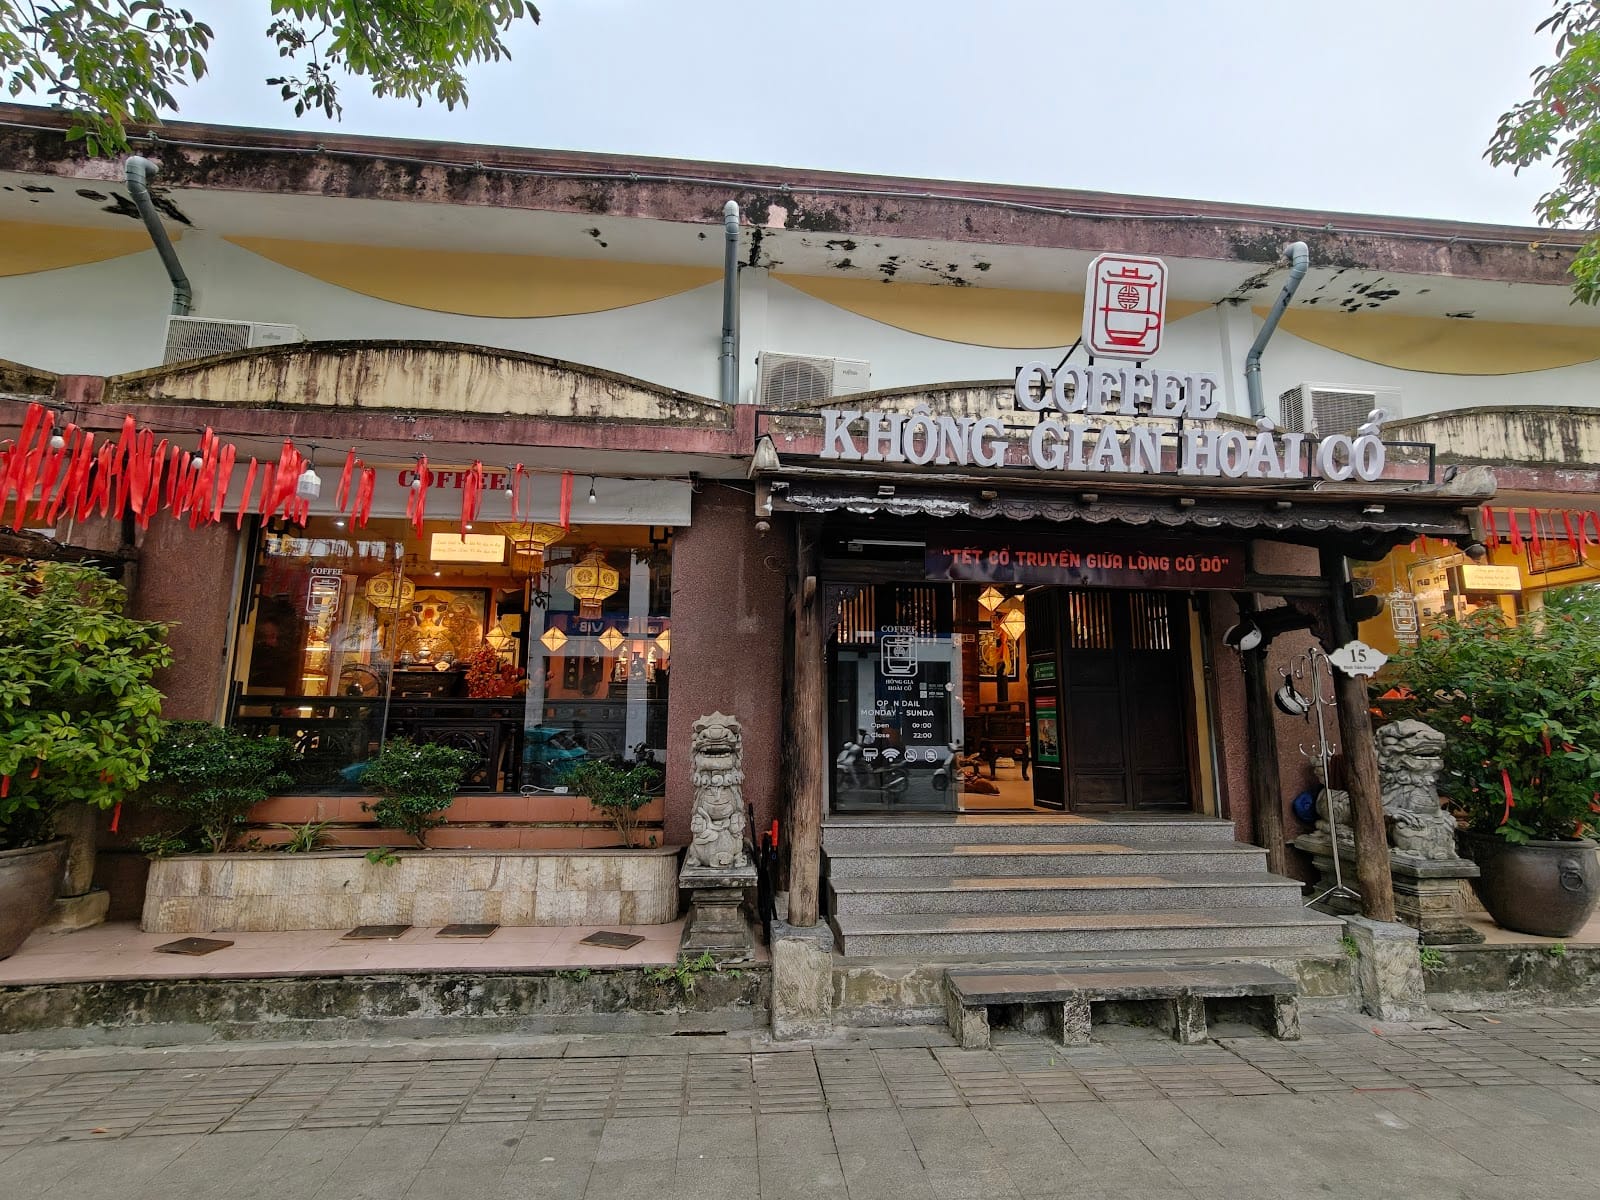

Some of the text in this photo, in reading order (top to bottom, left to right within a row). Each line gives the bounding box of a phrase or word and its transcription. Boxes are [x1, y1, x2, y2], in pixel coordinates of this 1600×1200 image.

[1015, 360, 1220, 419] COFFEE
[819, 403, 1387, 482] KHÔNG GIAN HOÀI CỔ
[1015, 548, 1081, 568] TRUYỀN
[1086, 551, 1123, 569] GIỮA
[1128, 550, 1170, 571] LÒNG
[311, 567, 344, 576] COFFEE
[1351, 648, 1367, 663] 15
